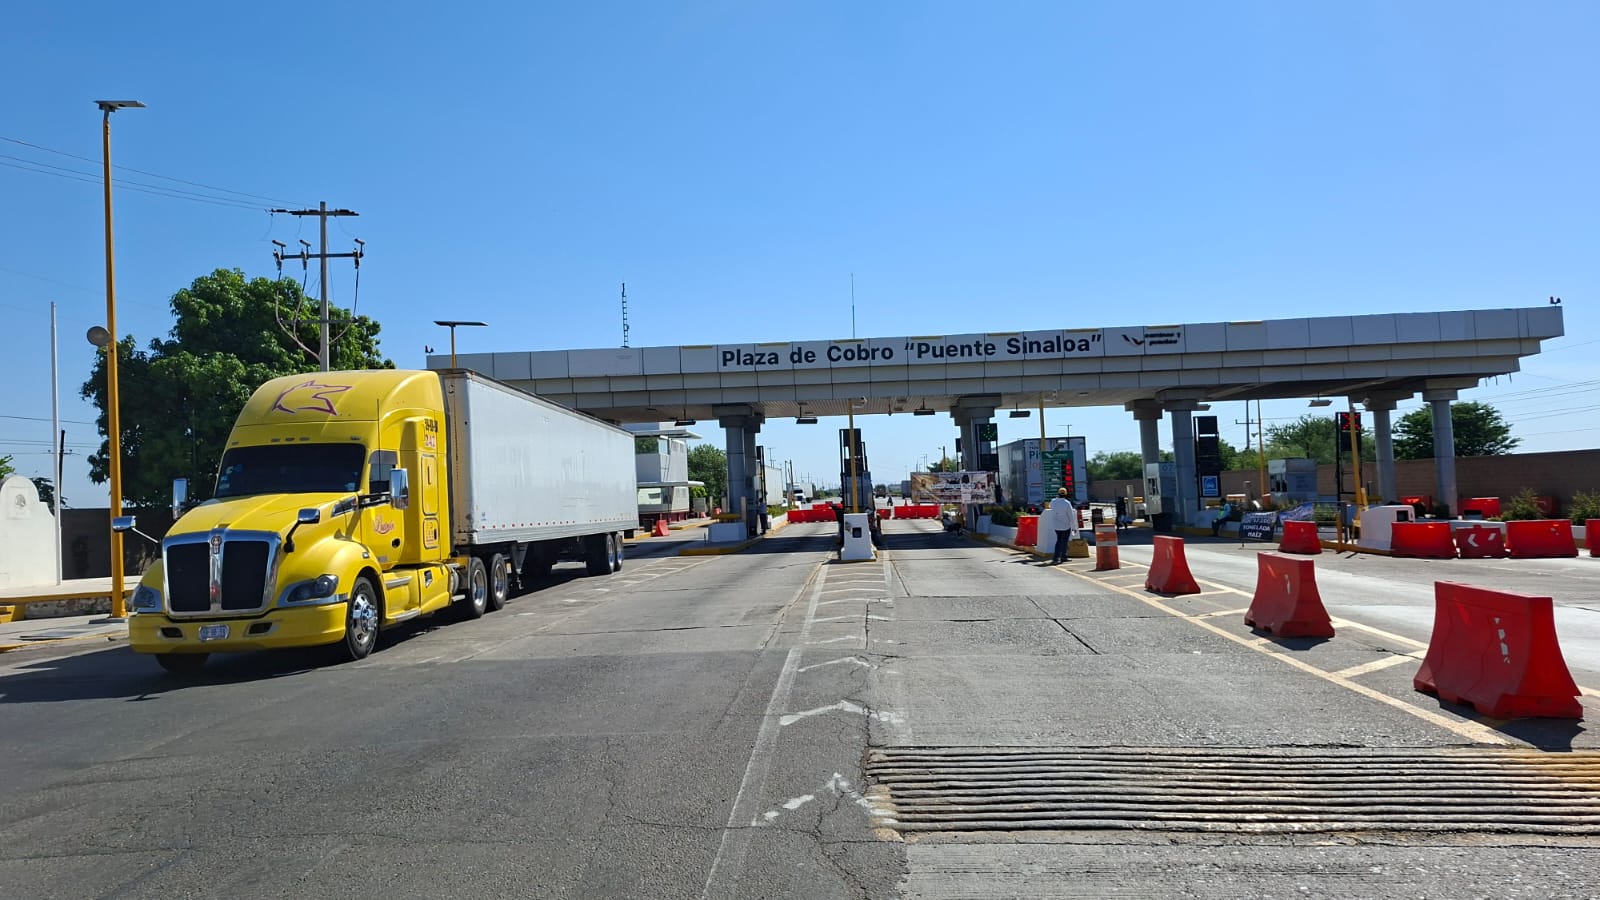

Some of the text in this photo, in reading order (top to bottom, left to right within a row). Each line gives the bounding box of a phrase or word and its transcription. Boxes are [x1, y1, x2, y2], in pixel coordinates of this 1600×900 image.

[721, 334, 1102, 367] Plaza de Cobro “Puente Sinaloa”
